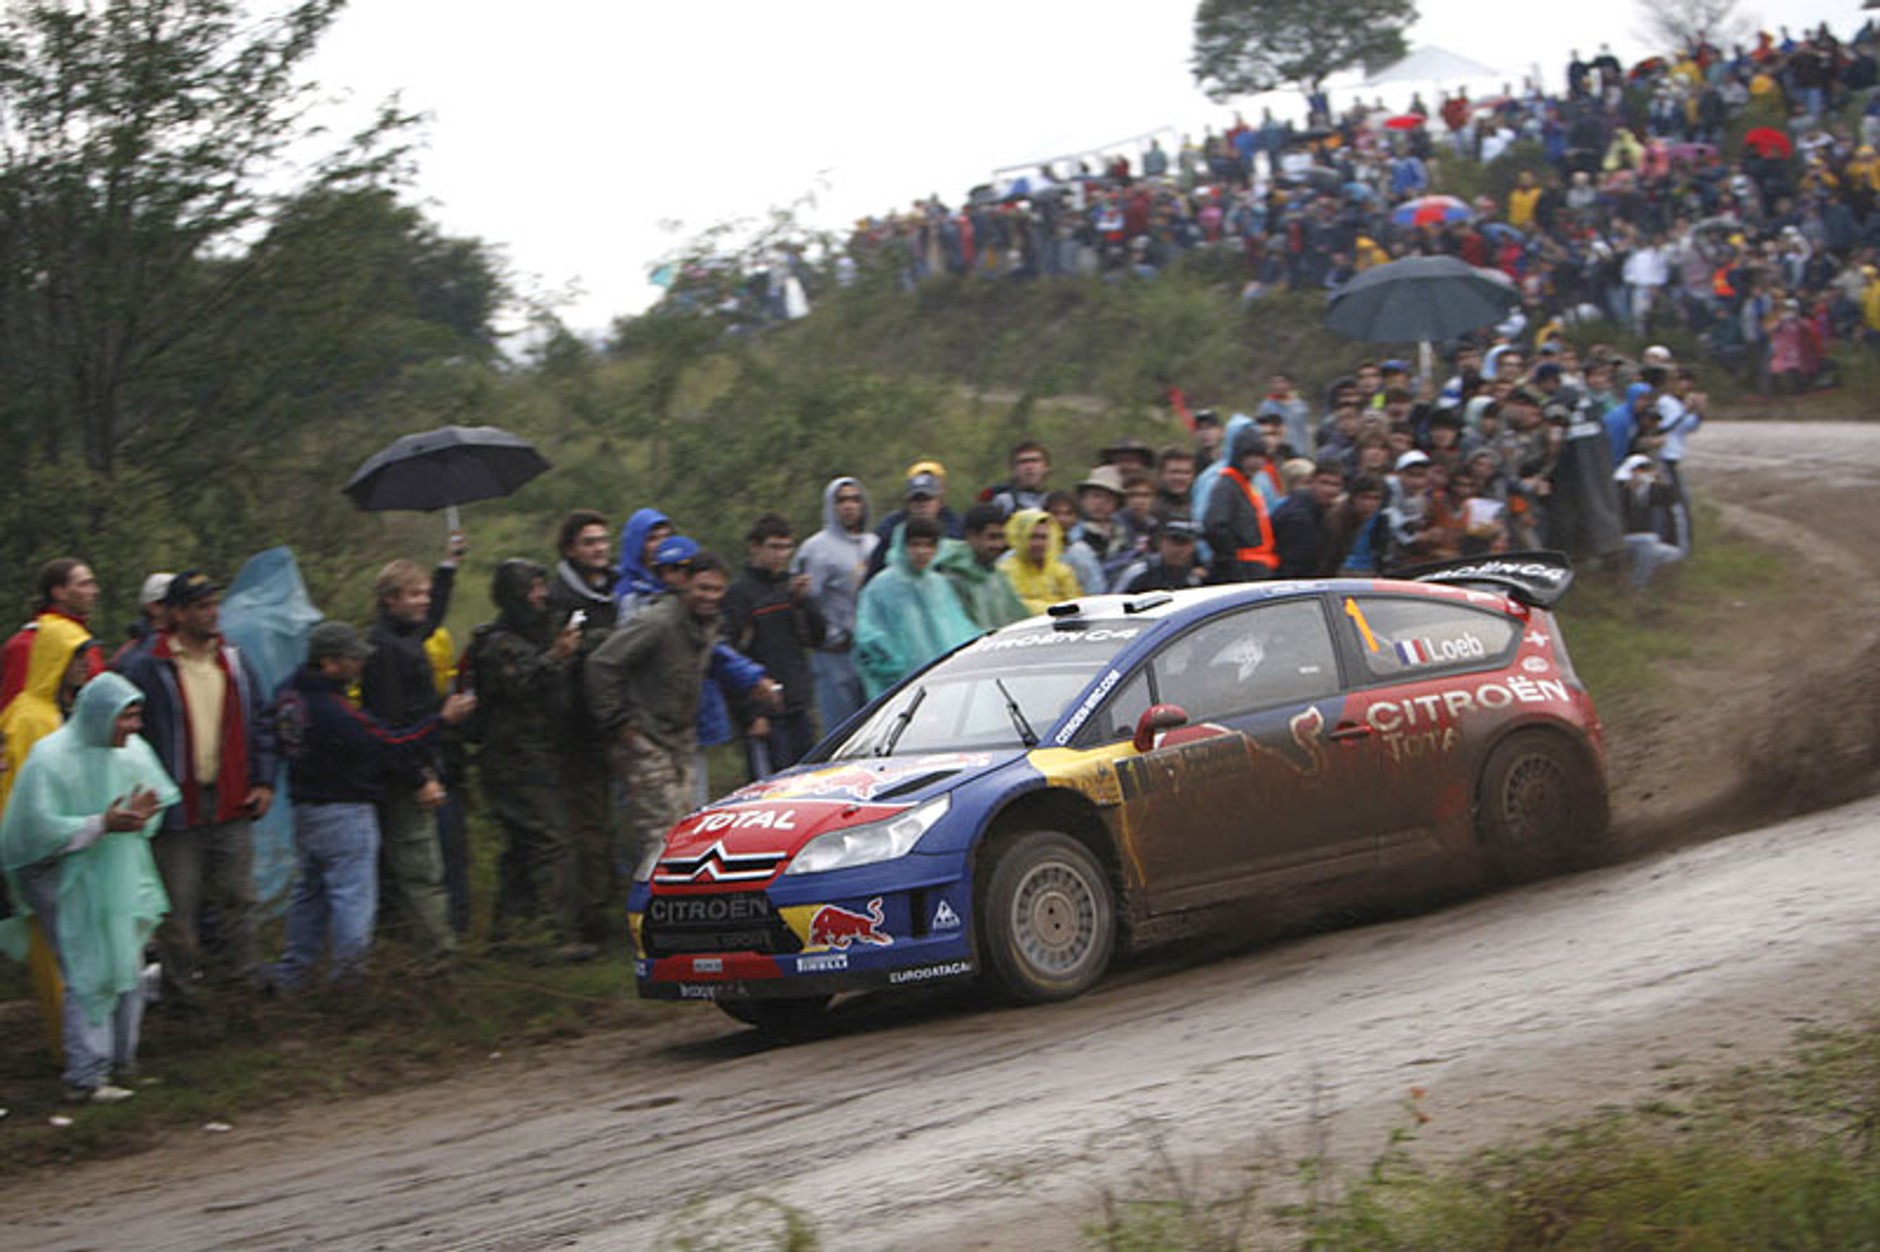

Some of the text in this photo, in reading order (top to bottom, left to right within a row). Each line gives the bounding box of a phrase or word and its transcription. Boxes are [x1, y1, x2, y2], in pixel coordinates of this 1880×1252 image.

[1344, 597, 1379, 653] 1
[974, 627, 1139, 654] ITROËN C4
[1424, 632, 1484, 662] Loeb
[1366, 675, 1571, 732] CITROËN
[692, 809, 797, 834] TOTAL
[651, 893, 769, 924] CITROËN
